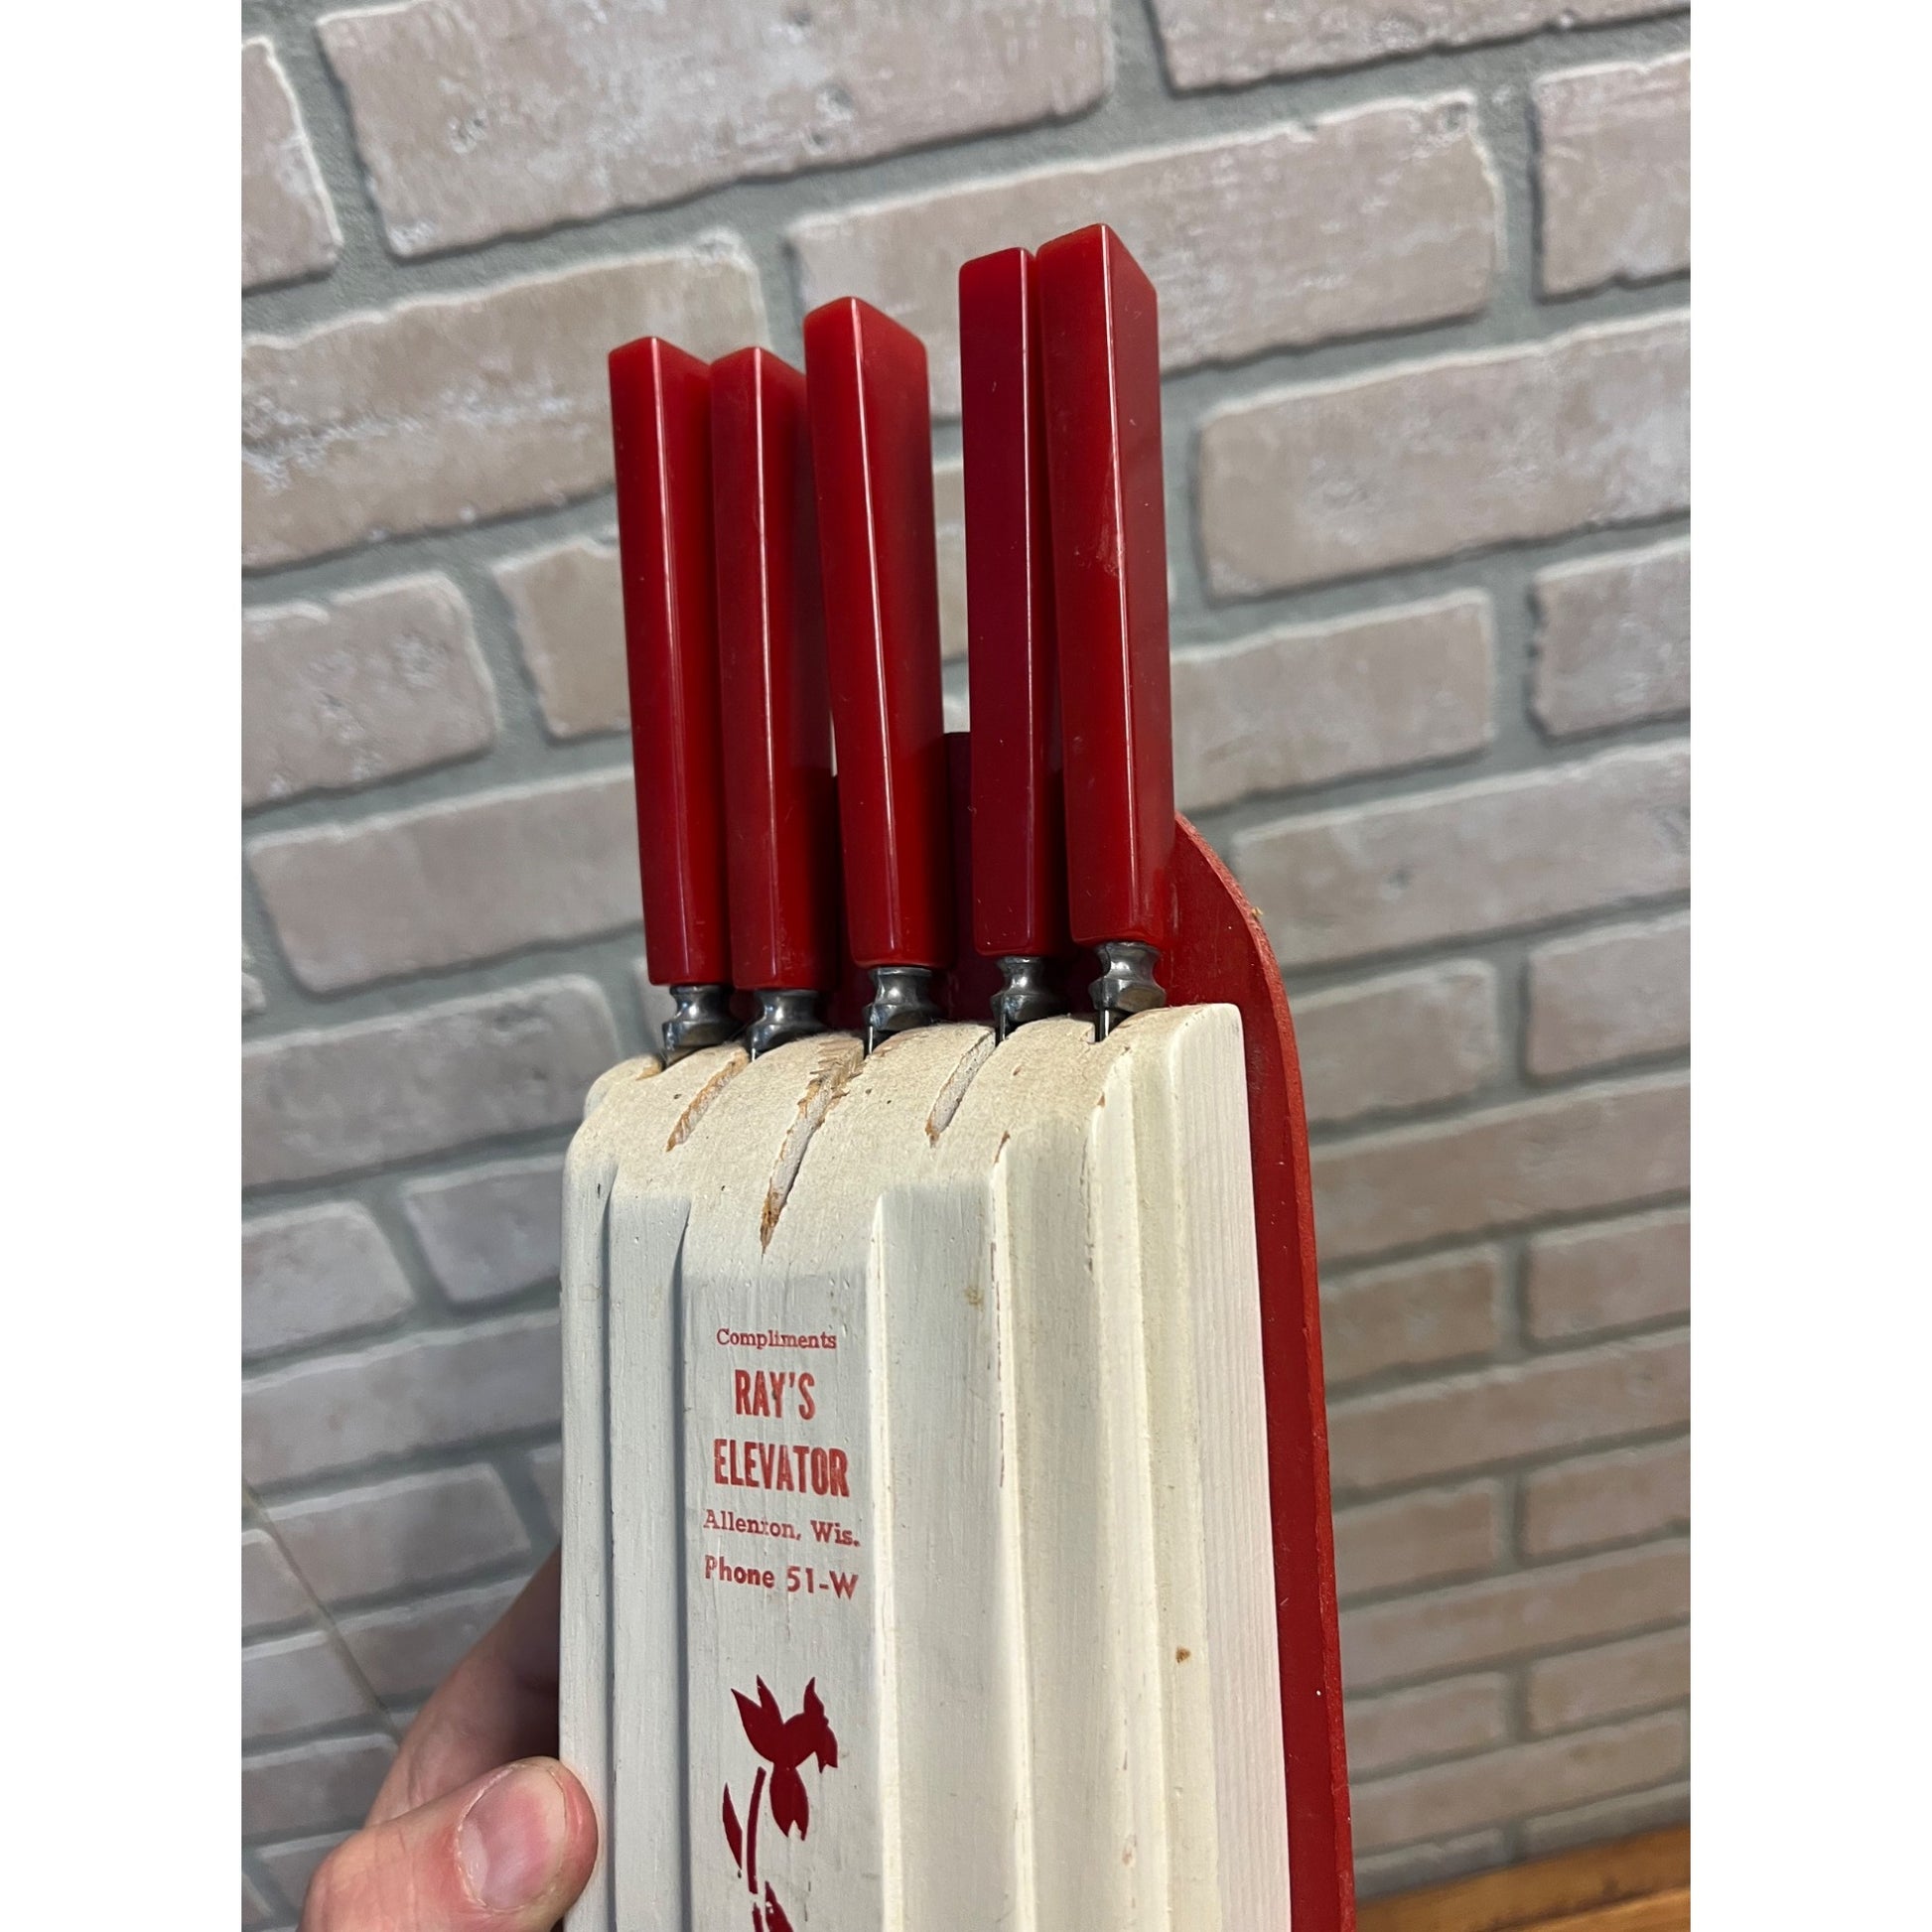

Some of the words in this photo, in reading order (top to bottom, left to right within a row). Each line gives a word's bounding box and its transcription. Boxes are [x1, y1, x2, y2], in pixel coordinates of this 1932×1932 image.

[716, 1327, 837, 1350] Compliments
[735, 1369, 816, 1420] RAY'S
[714, 1439, 850, 1497] ELEVATOR
[810, 1520, 861, 1547] Wis.
[705, 1556, 775, 1589] Phone
[786, 1565, 859, 1599] 51-W
